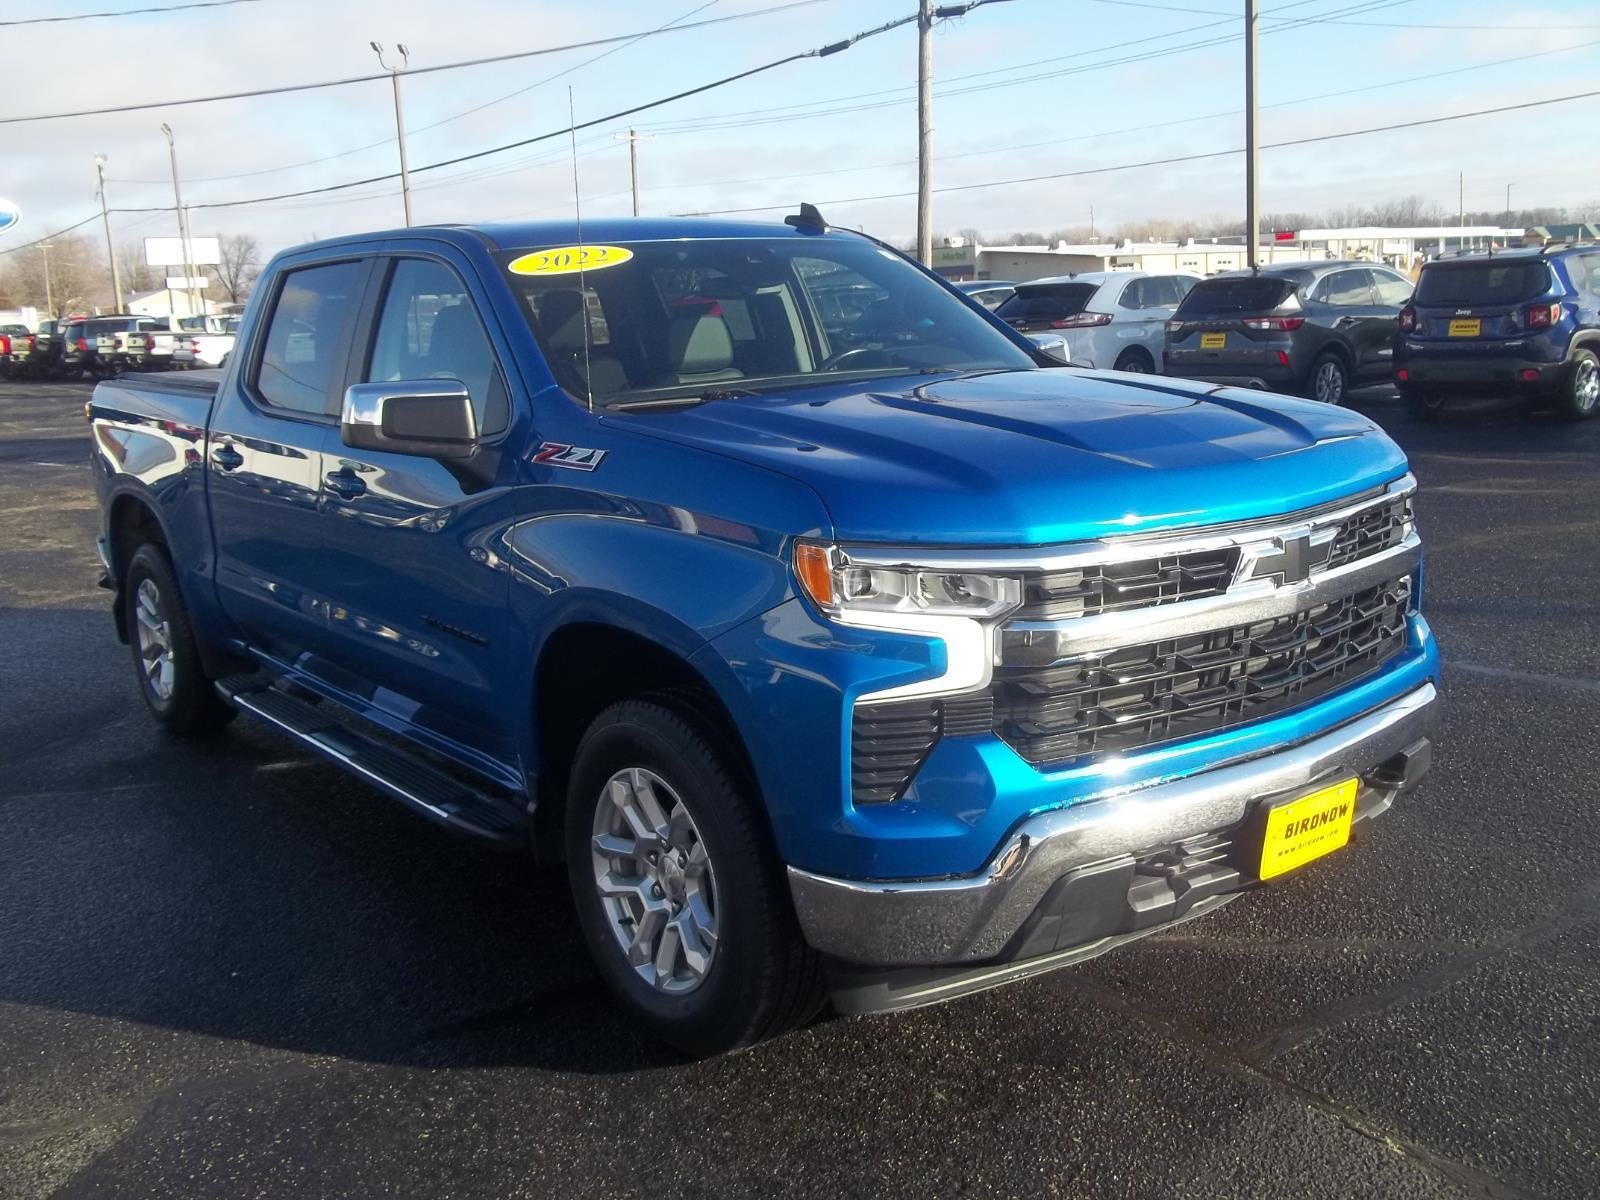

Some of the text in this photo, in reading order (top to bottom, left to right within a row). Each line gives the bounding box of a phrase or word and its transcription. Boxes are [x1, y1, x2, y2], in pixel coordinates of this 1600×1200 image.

[536, 249, 608, 271] 2022
[531, 441, 608, 472] Z71
[1284, 801, 1350, 839] BIRDNOW
